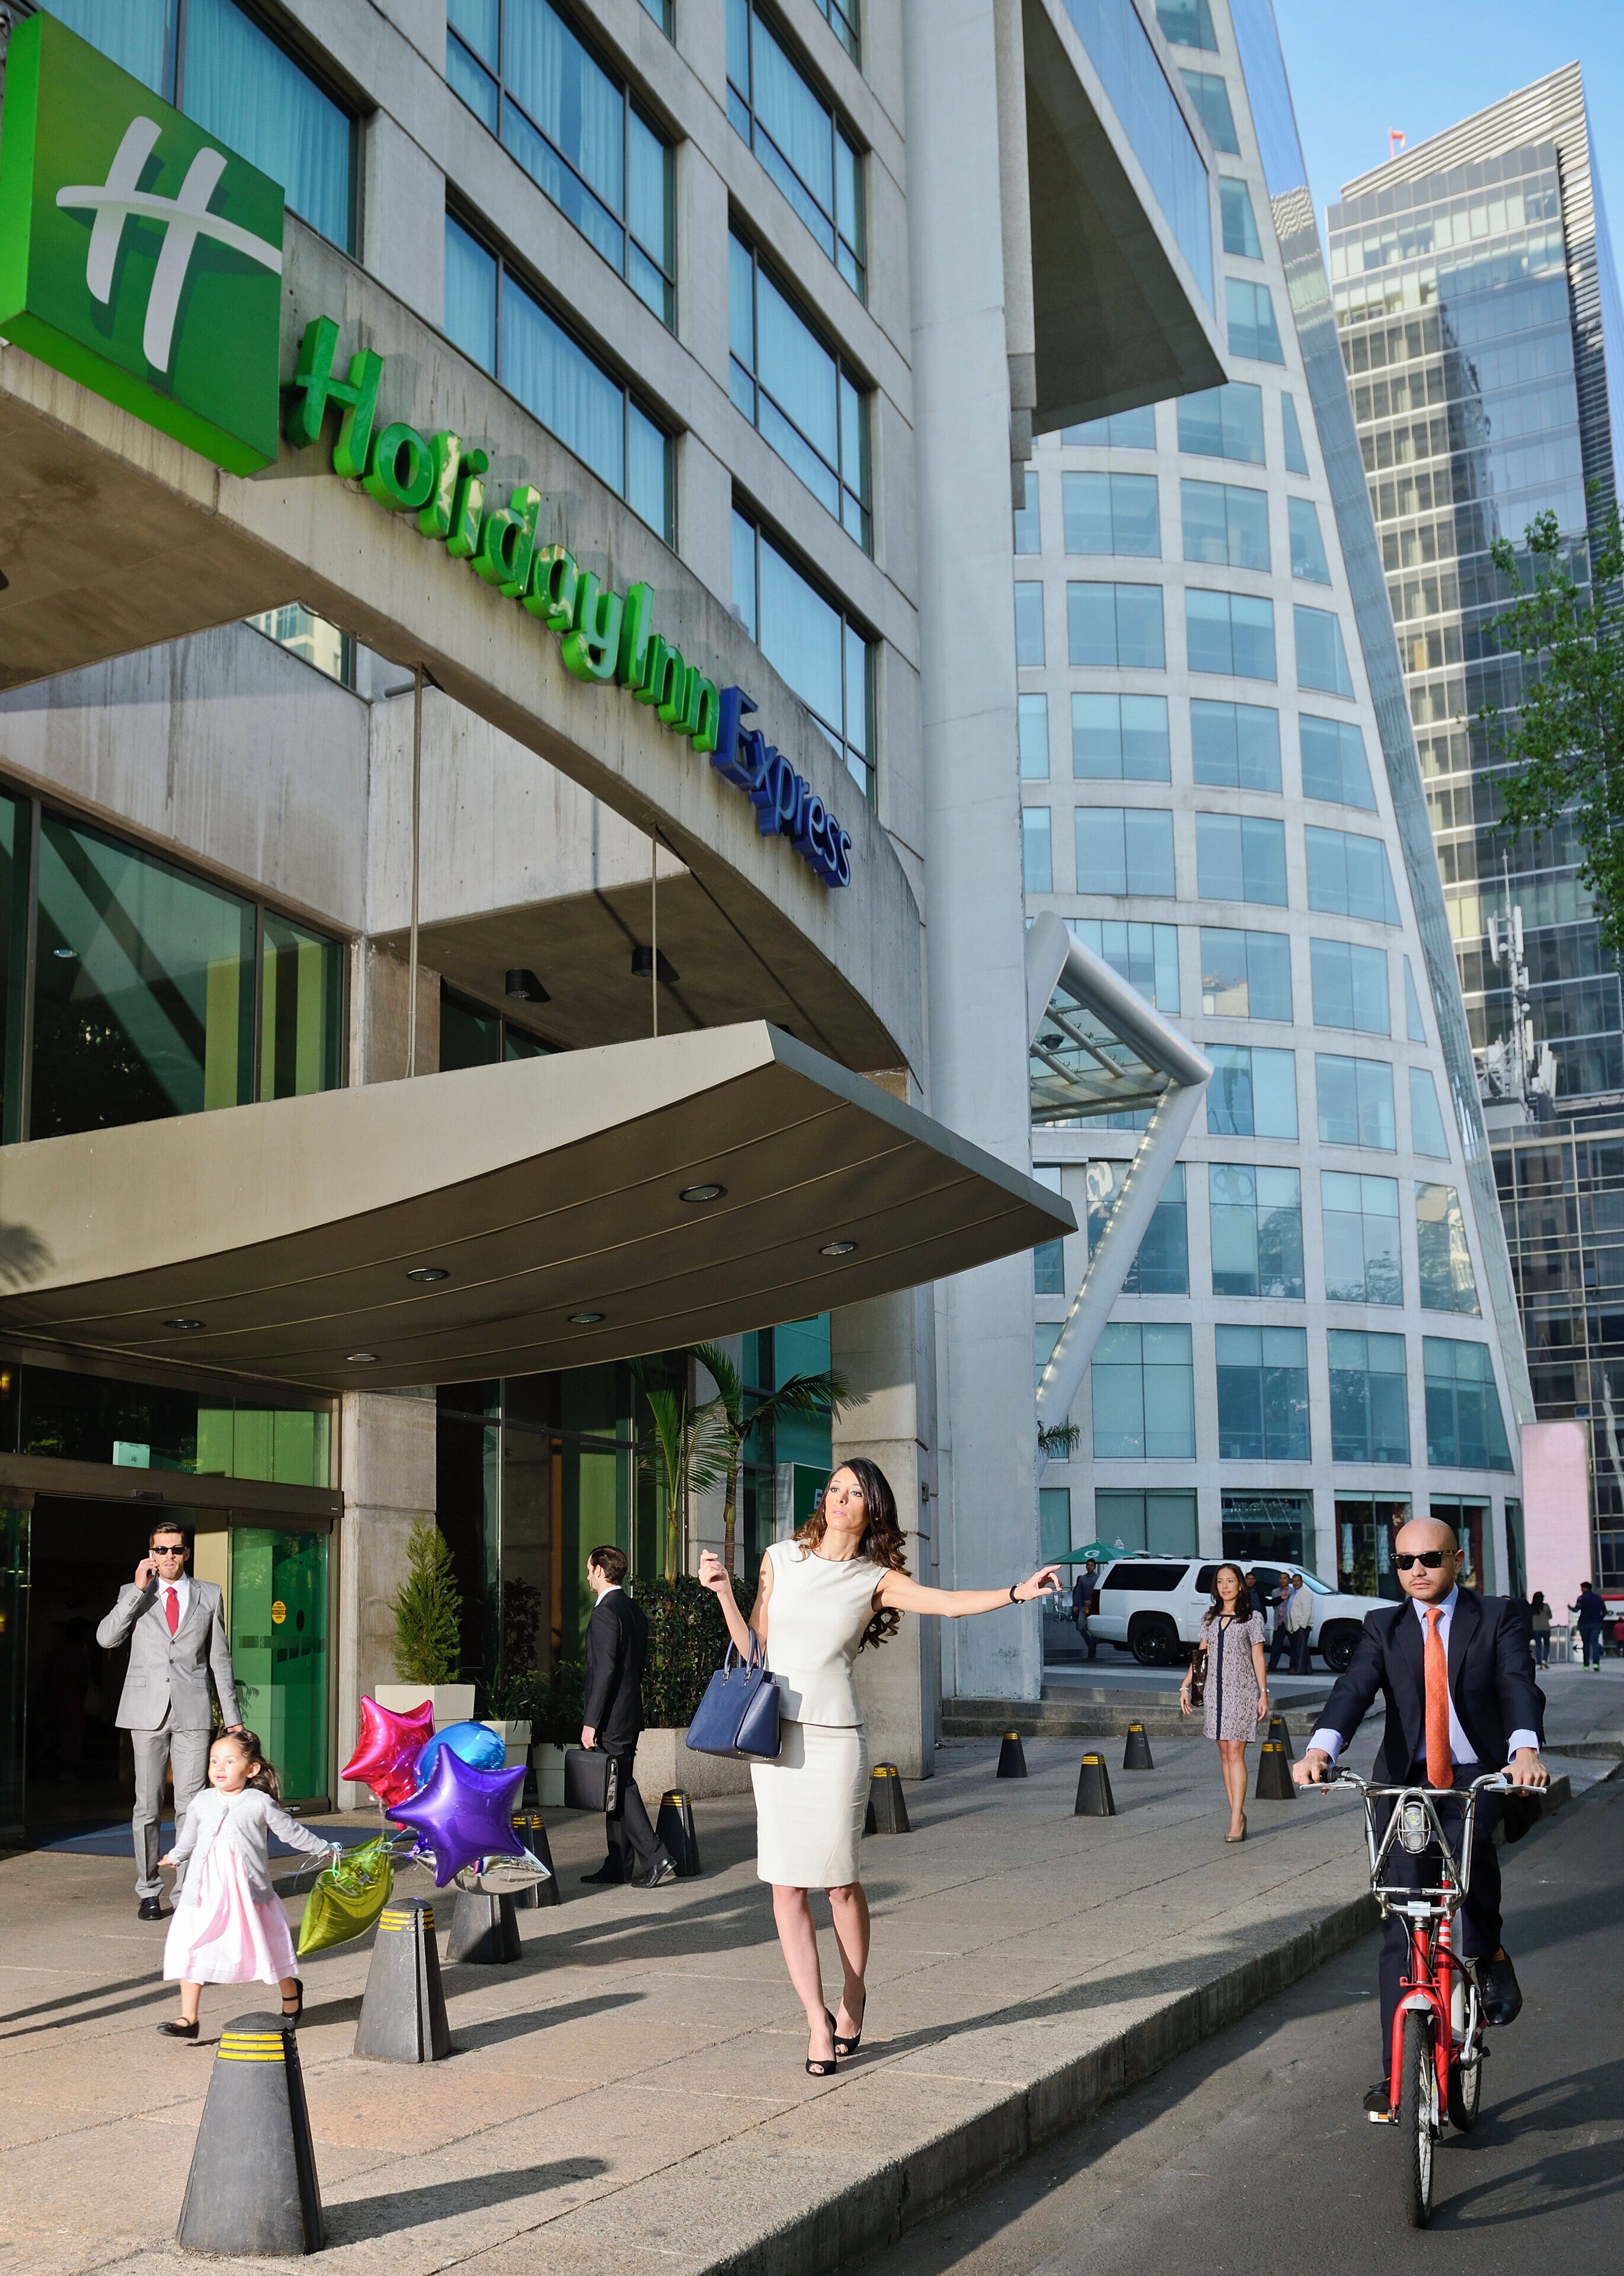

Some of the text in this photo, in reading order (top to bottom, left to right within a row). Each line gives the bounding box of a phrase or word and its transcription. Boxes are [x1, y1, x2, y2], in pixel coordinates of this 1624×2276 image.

[55, 116, 282, 373] H
[284, 315, 852, 888] Holiday Inn Express
